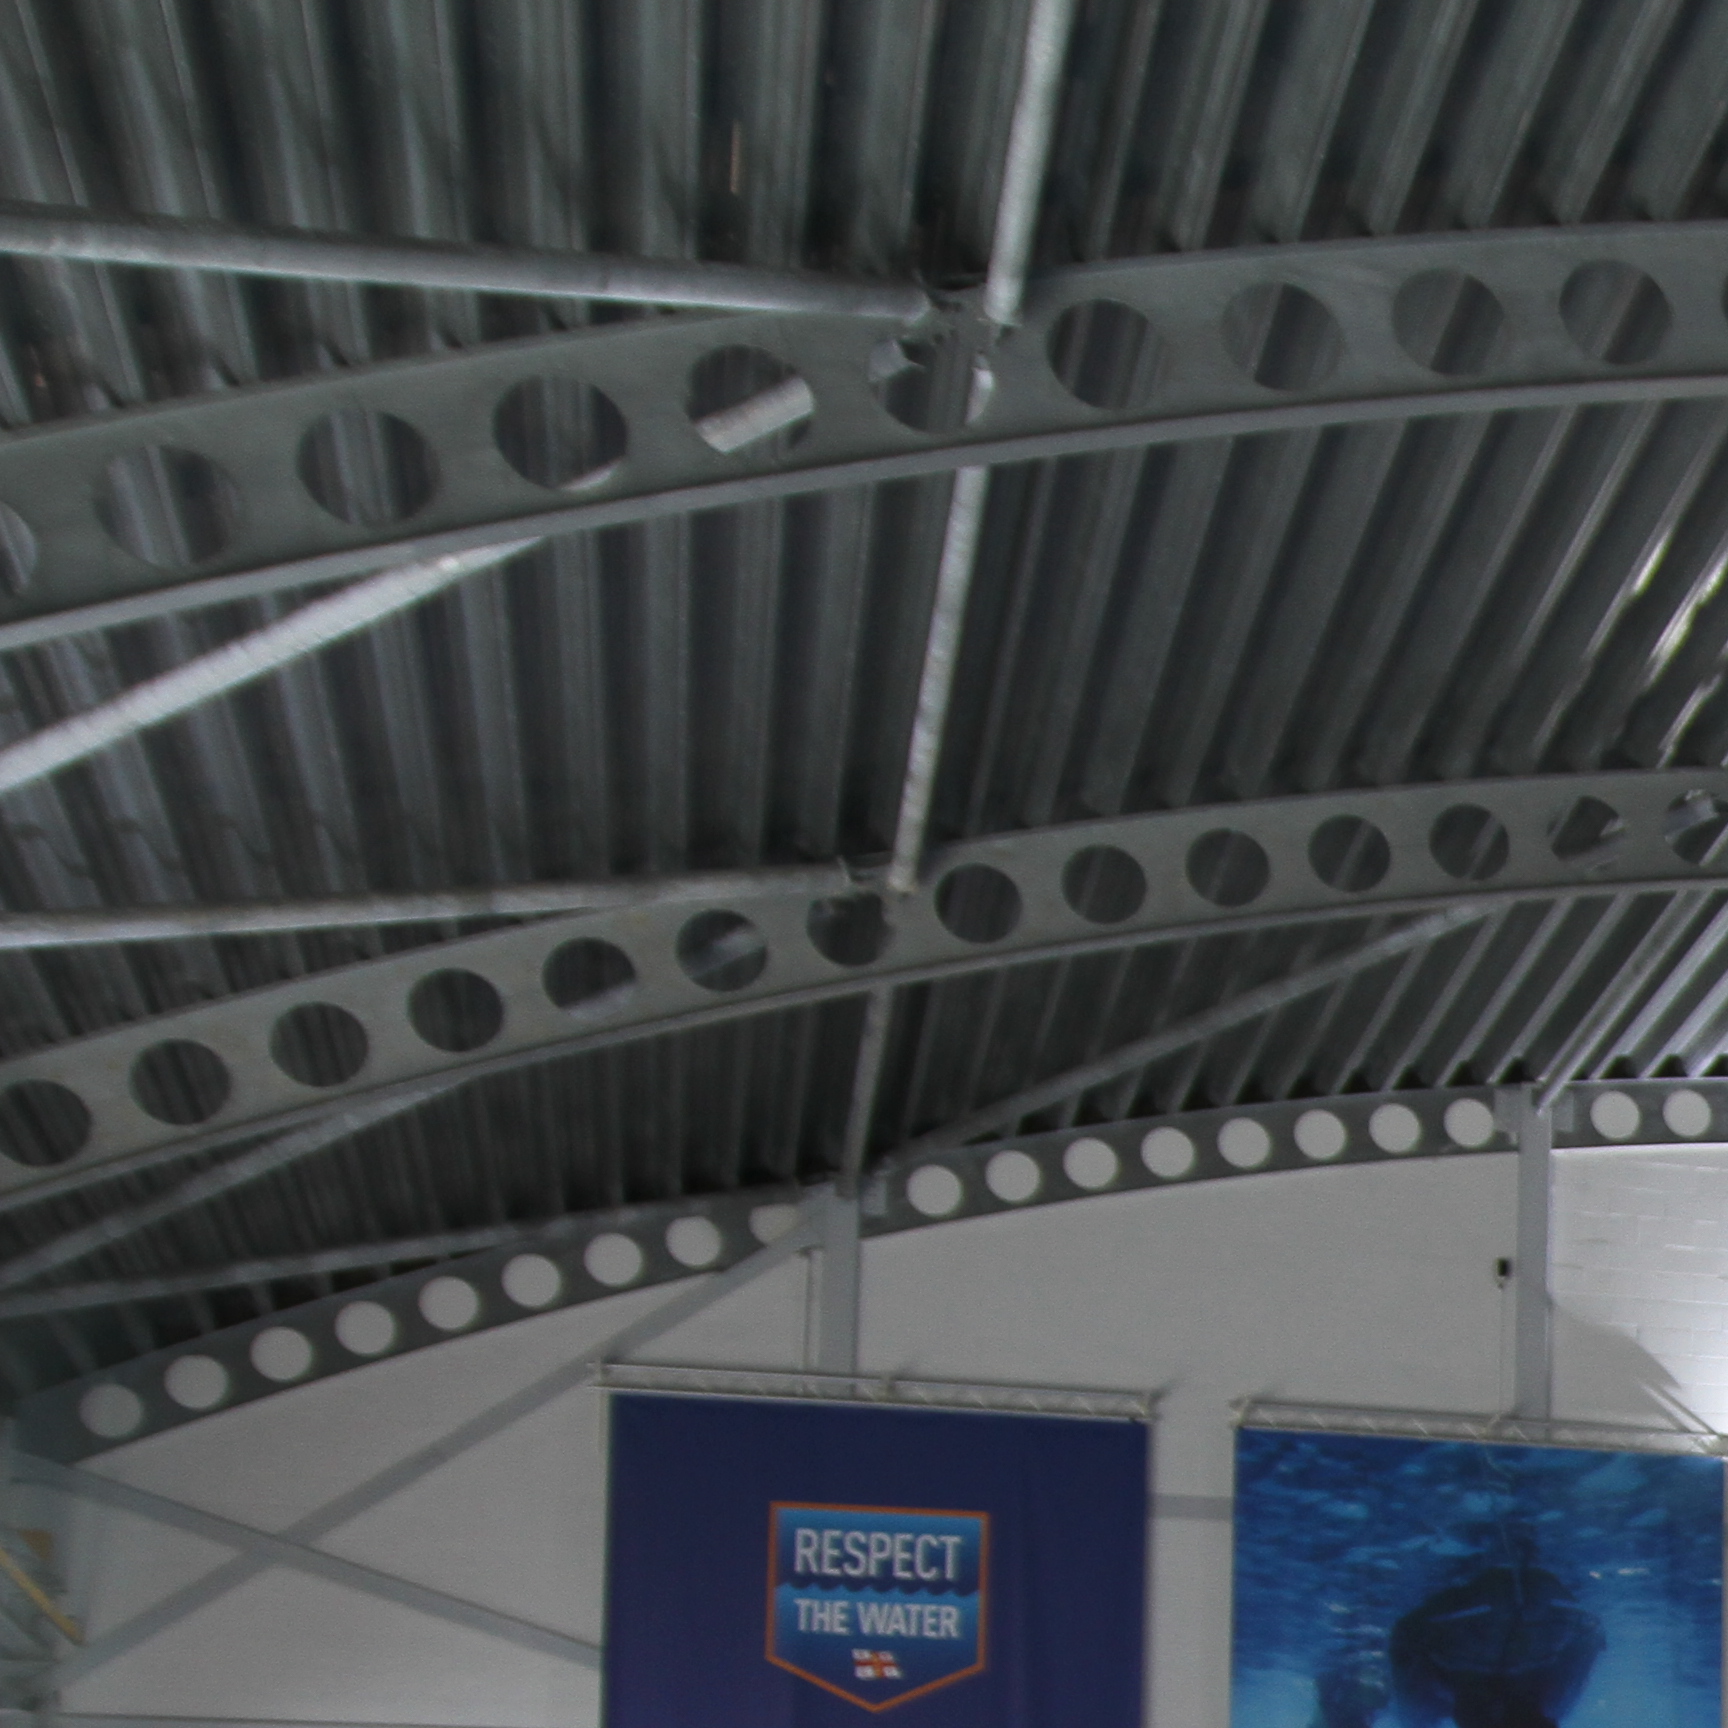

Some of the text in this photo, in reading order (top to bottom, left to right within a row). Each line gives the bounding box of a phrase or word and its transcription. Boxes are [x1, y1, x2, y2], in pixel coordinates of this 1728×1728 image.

[794, 1527, 962, 1581] RESPECT
[793, 1597, 961, 1639] THE WATER
